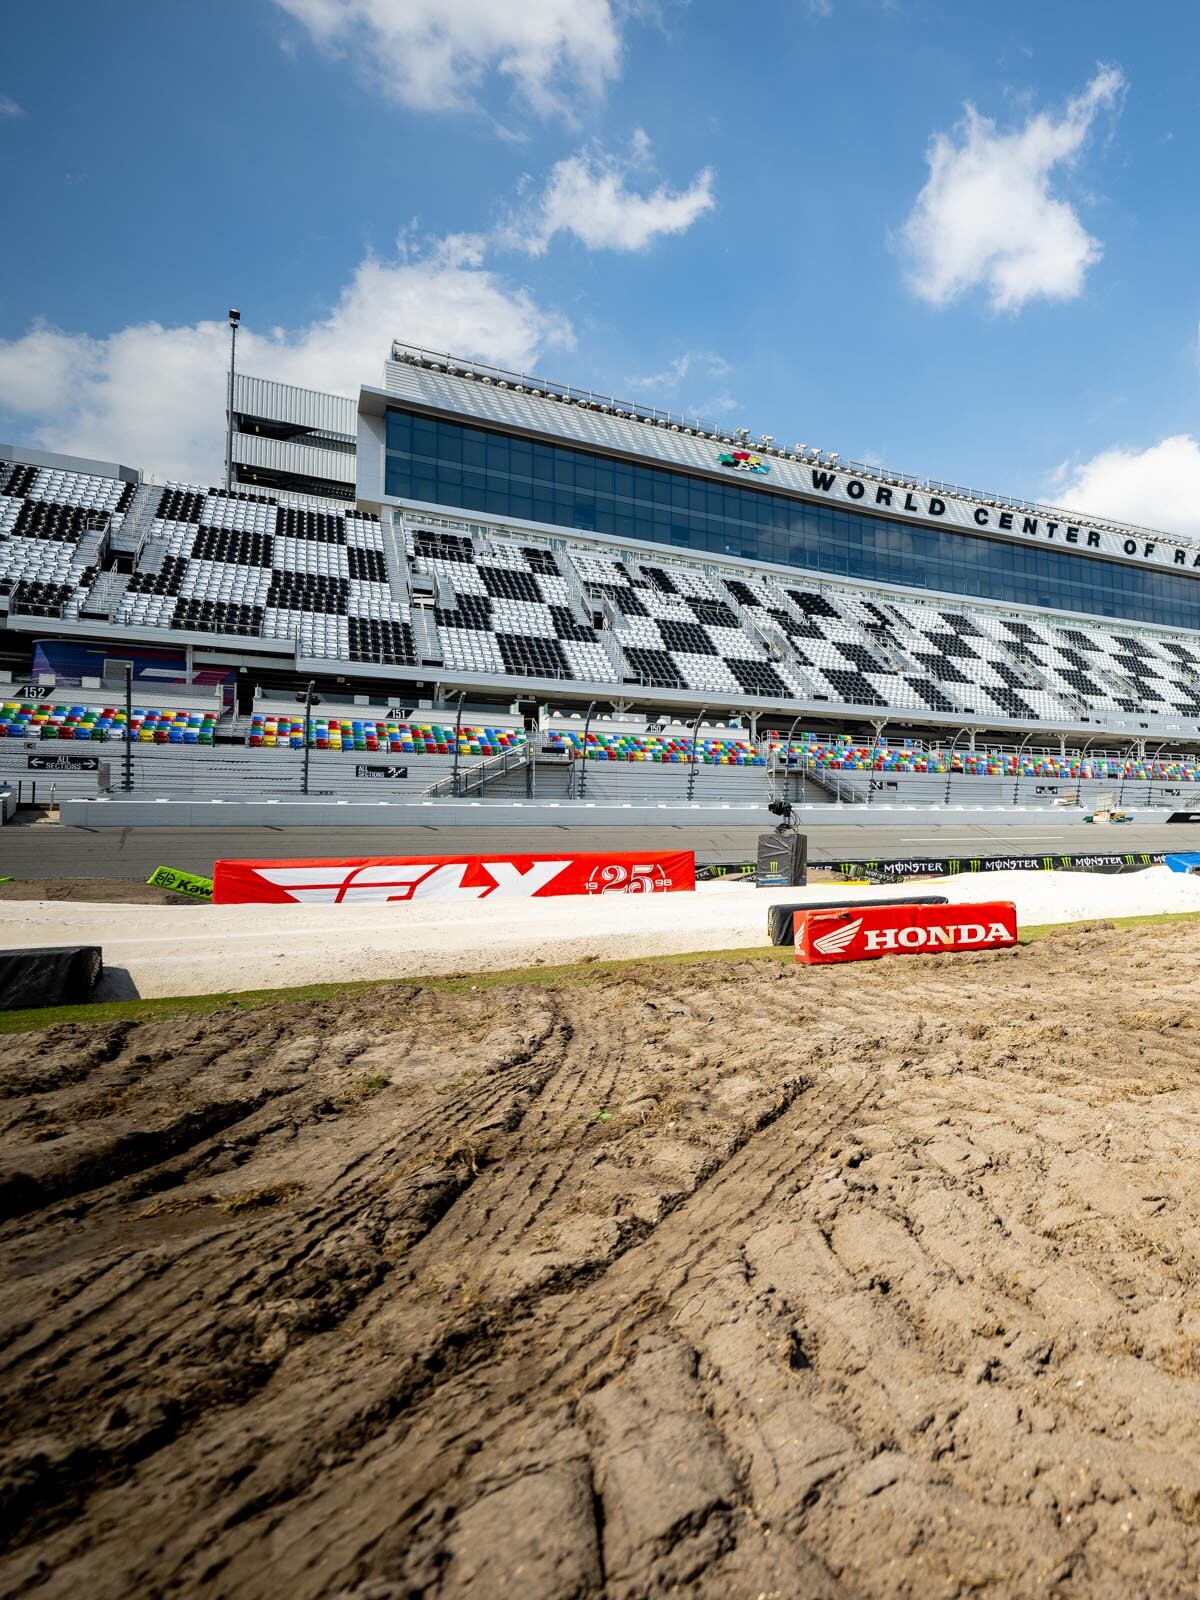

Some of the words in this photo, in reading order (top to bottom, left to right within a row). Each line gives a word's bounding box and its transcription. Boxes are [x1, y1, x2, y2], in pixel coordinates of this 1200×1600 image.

[811, 469, 946, 516] WORLD
[974, 507, 1101, 548] CENTER
[1124, 539, 1156, 559] OF
[23, 686, 46, 698] 152
[391, 709, 406, 719] 151
[649, 724, 665, 734] 150
[57, 756, 70, 764] ALL
[45, 762, 82, 771] SECTIONS
[985, 859, 1039, 871] MONSTER
[1075, 855, 1123, 867] MONSTER
[884, 861, 944, 875] MONSTER
[584, 882, 598, 890] 19
[601, 864, 655, 895] 25
[655, 879, 673, 887] 98
[864, 922, 1014, 951] HONDA
